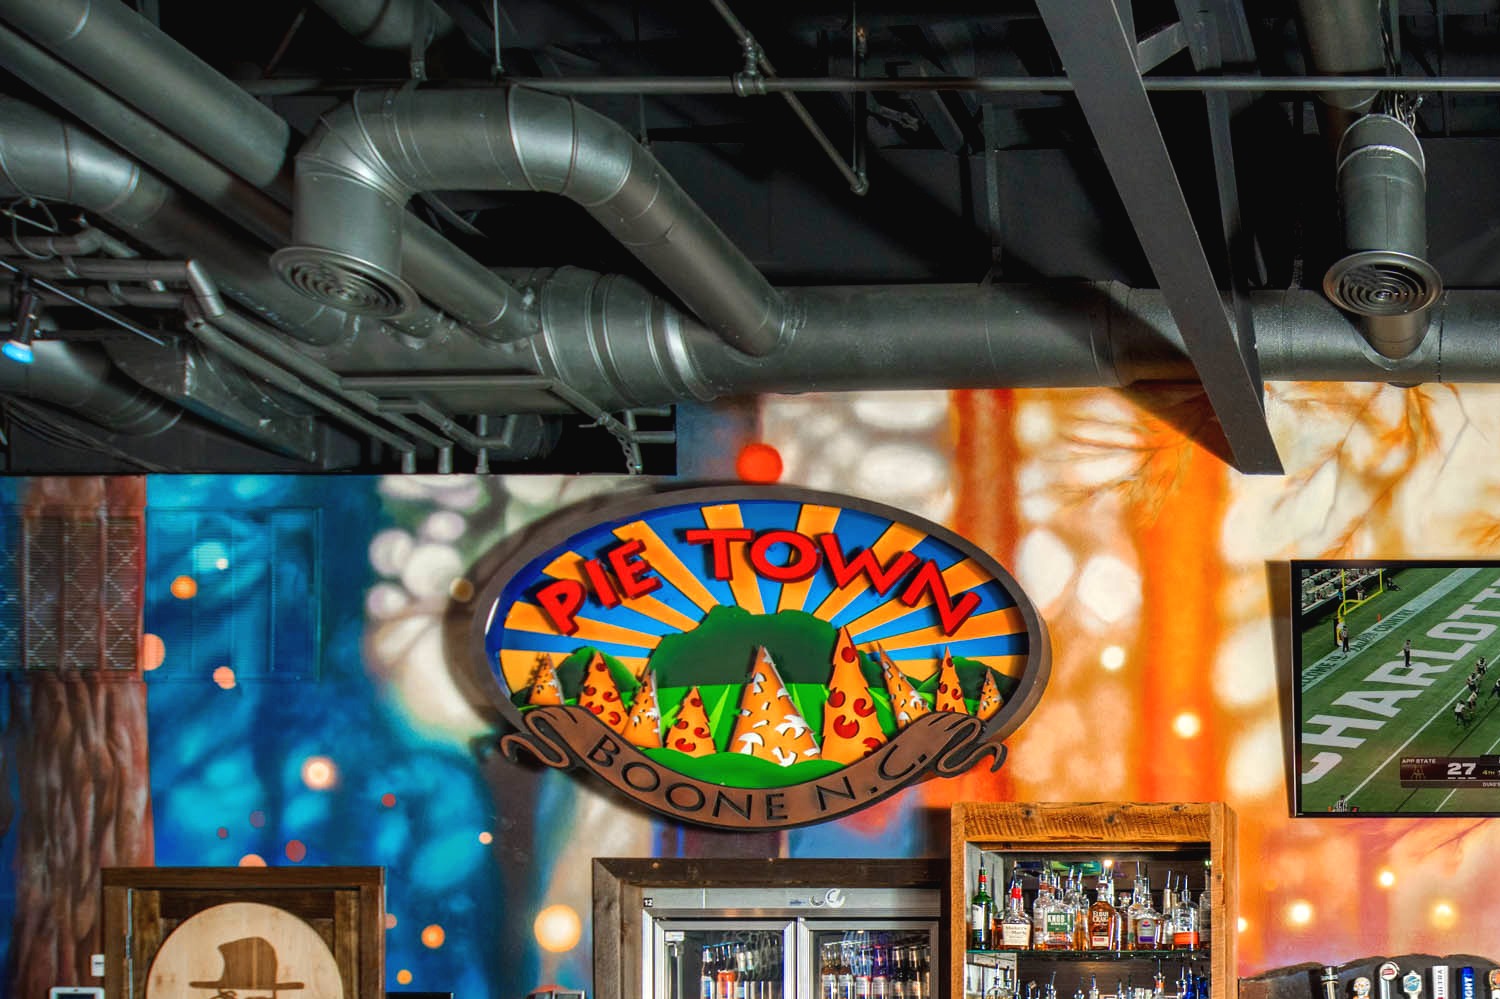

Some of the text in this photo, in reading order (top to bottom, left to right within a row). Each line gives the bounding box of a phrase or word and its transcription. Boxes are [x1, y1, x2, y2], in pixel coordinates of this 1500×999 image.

[535, 528, 982, 637] PIE TOWN
[587, 728, 788, 821] BOONE
[1447, 763, 1477, 775] 27
